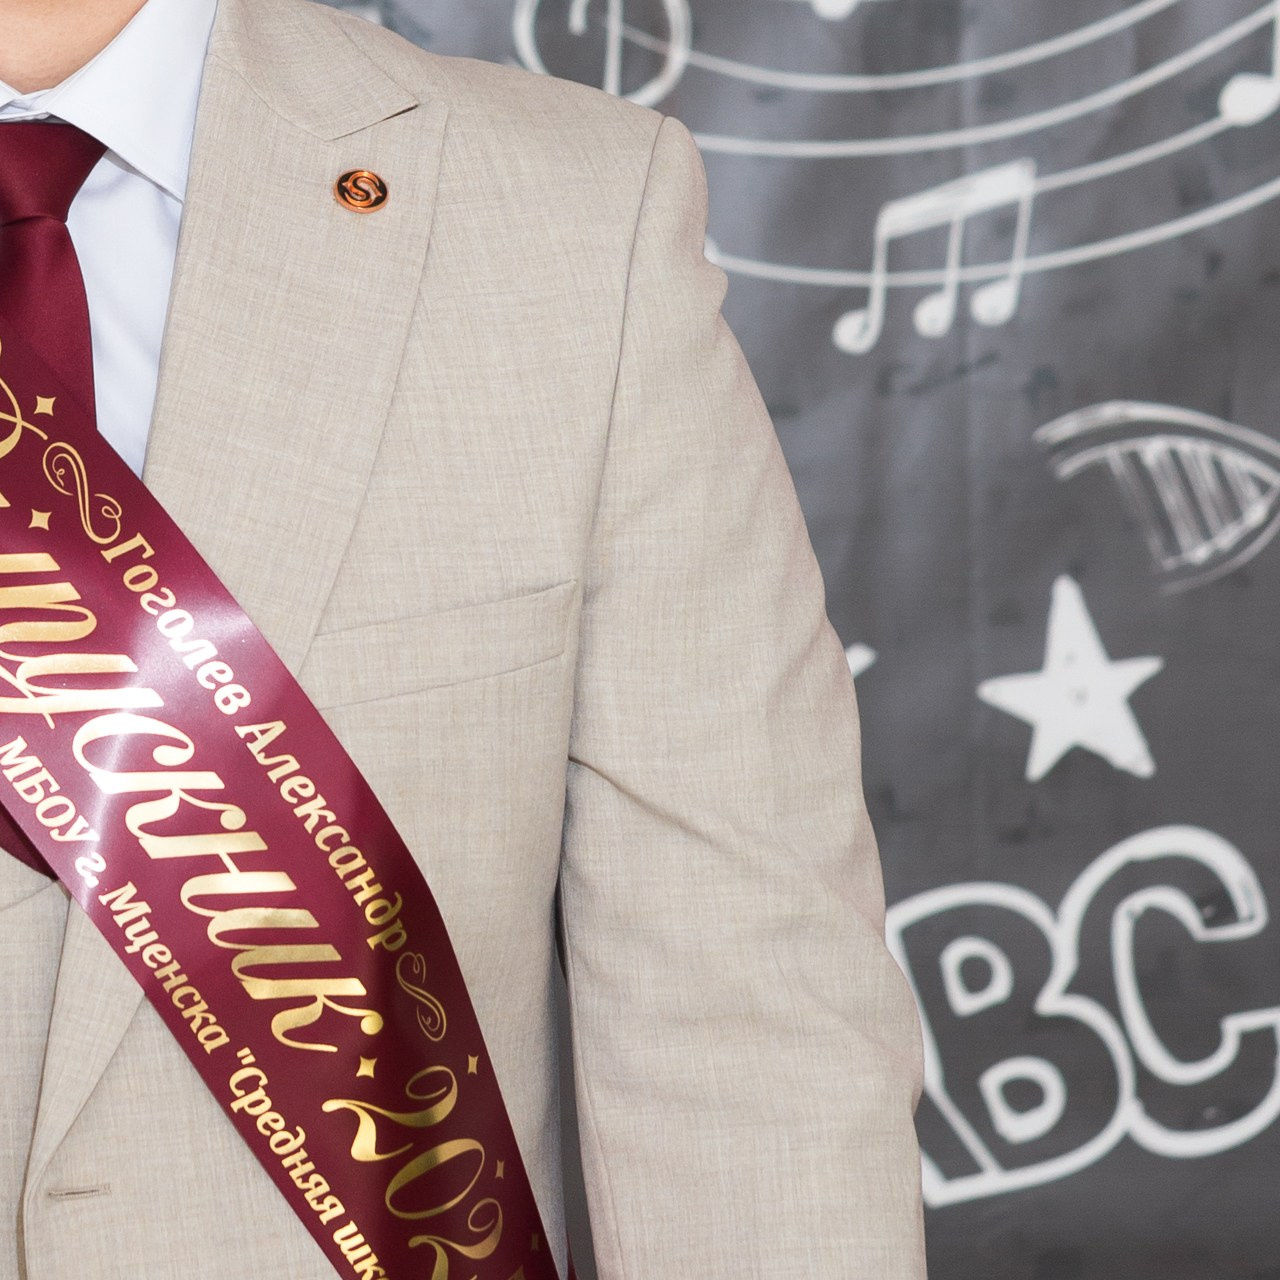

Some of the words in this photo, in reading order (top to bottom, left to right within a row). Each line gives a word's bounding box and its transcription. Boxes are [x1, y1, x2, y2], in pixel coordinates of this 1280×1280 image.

[100, 531, 252, 715] Гоголев
[235, 719, 409, 953] Александр
[74, 851, 107, 889] г.
[97, 880, 230, 1055] Мценска
[228, 1047, 346, 1226] "Средняя
[883, 824, 1280, 1208] BC
